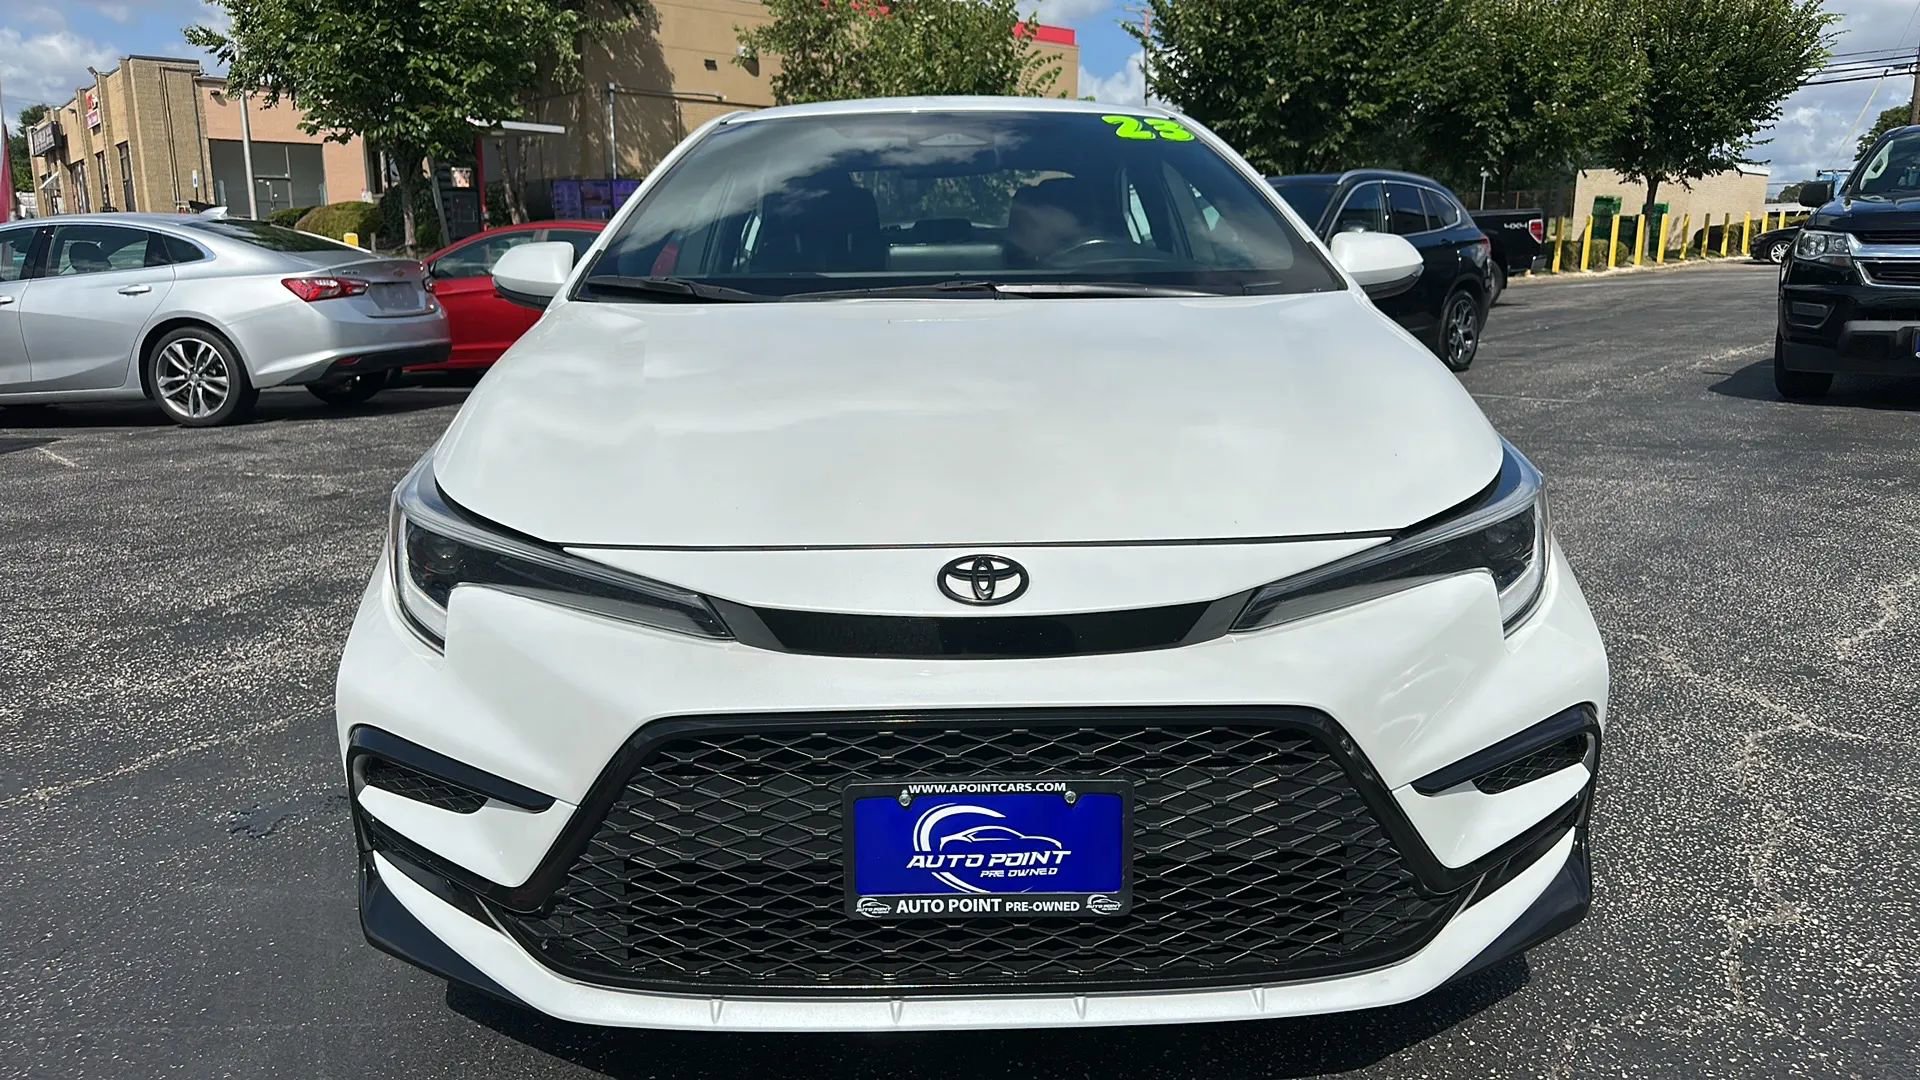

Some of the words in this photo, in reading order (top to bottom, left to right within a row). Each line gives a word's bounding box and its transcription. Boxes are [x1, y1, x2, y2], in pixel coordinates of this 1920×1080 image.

[1101, 115, 1195, 141] 23
[908, 781, 1067, 794] WWW.APOINTCARS.COM
[906, 854, 985, 869] AUTO
[988, 850, 1072, 867] POINT
[979, 869, 1005, 878] PRE
[1007, 867, 1058, 877] OWNED
[895, 899, 945, 914] AUTO
[948, 898, 1002, 913] POINT
[1005, 901, 1080, 912] PRE-OWNED
